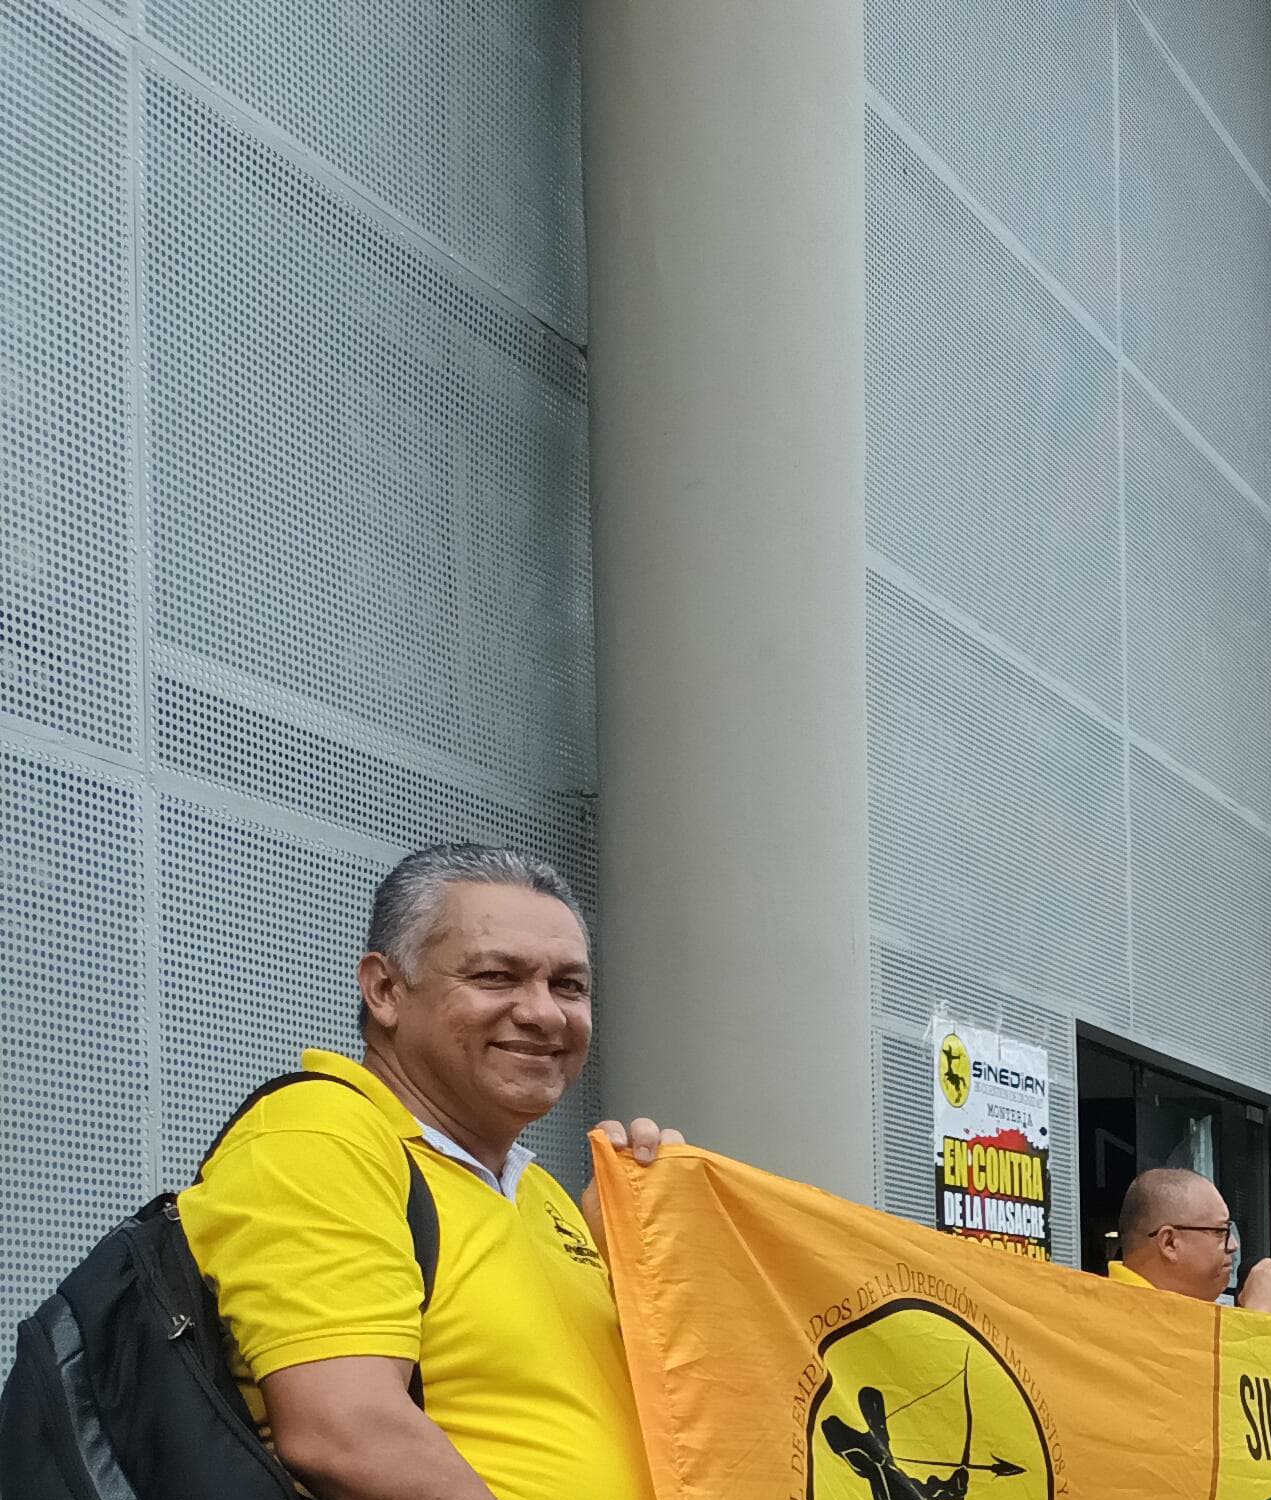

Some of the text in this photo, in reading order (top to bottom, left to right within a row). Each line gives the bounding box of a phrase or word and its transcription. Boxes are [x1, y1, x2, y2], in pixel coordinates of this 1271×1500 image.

[943, 1138, 1043, 1200] EN CONTRA
[944, 1191, 1046, 1239] DE LA MASACRE
[791, 1432, 806, 1477] DE
[856, 1287, 880, 1314] DE
[875, 1275, 897, 1297] LA
[981, 1312, 1001, 1348] DE
